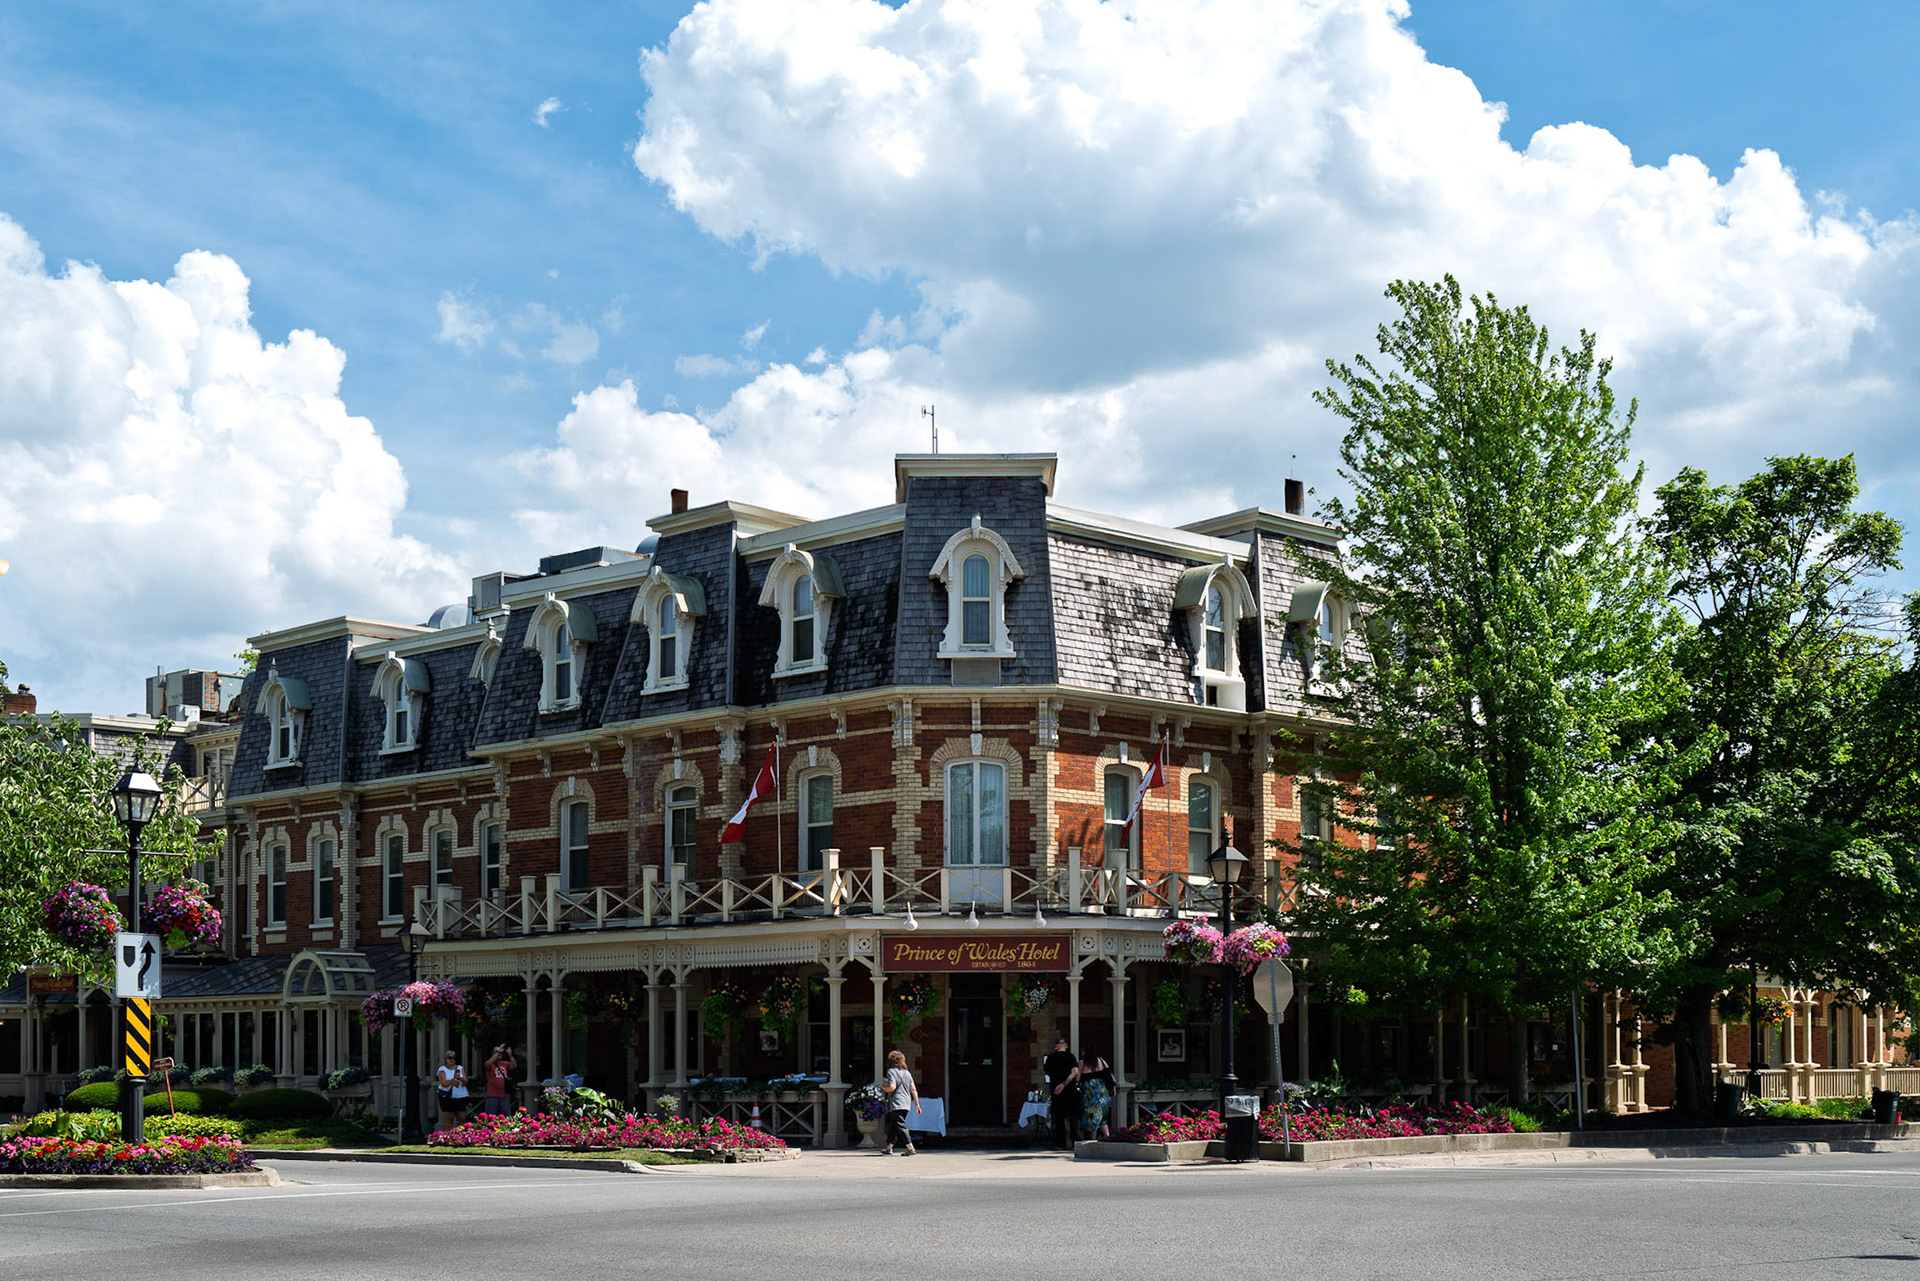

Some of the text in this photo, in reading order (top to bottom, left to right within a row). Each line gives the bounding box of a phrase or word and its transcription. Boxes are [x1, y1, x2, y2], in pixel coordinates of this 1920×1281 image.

[894, 942, 1061, 965] Prince of Wales Hotel
